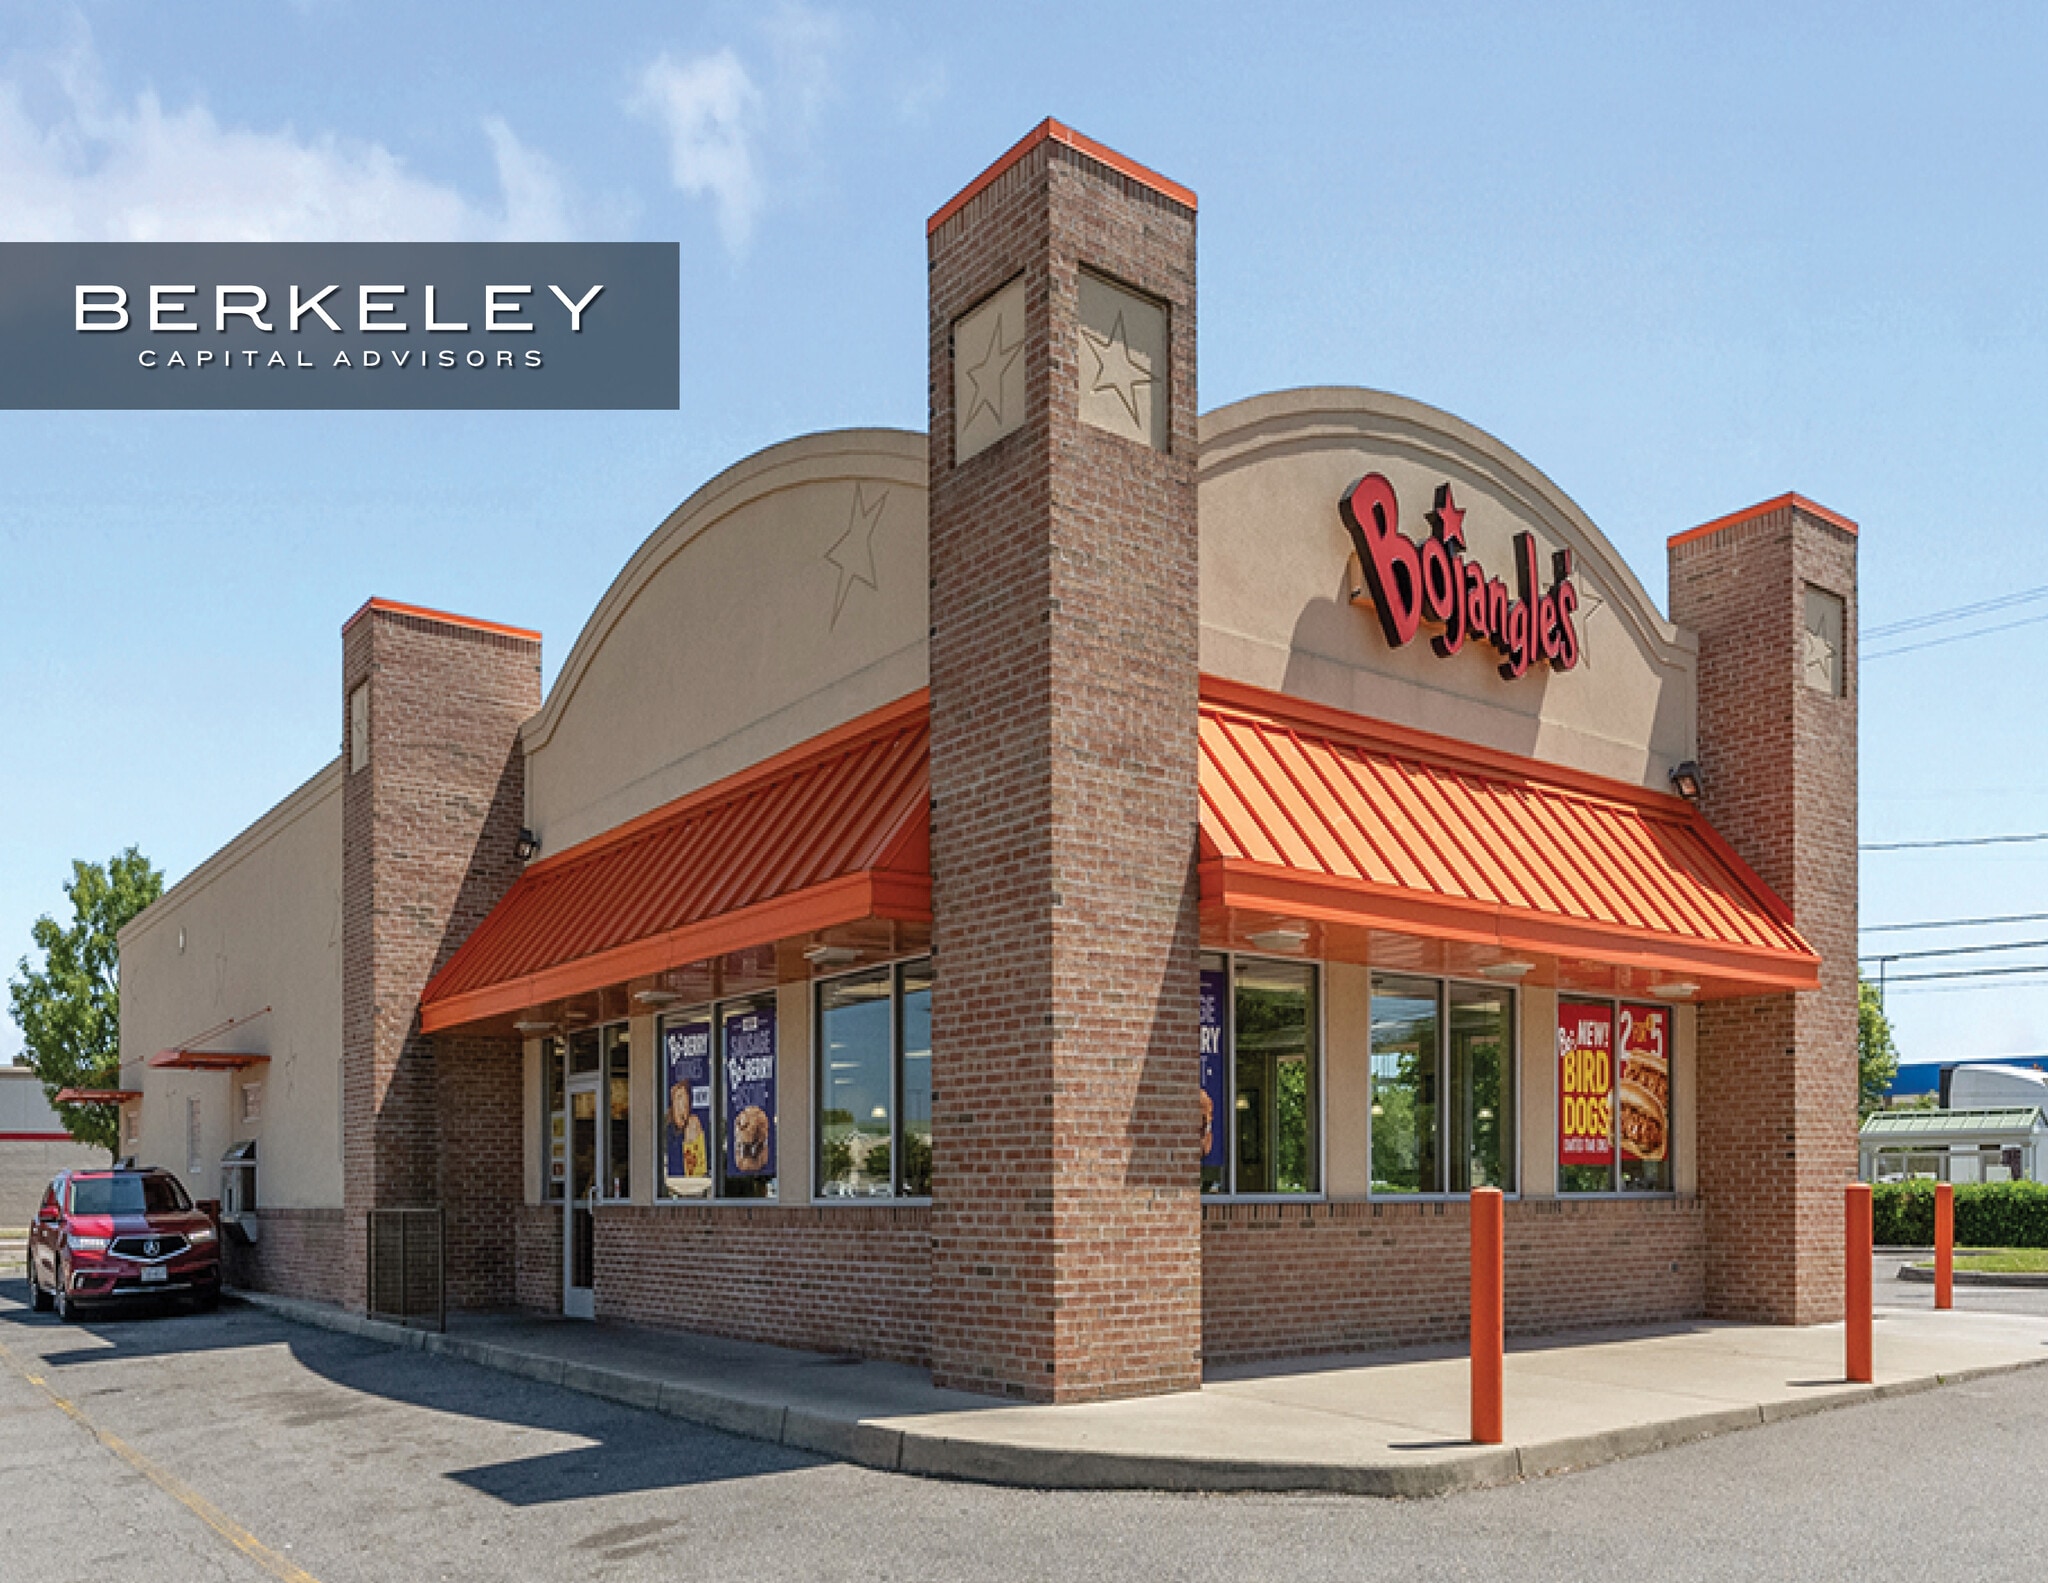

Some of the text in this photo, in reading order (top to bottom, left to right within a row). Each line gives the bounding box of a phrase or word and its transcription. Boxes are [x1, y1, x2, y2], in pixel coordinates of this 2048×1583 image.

[1578, 1020, 1609, 1047] NEW!
[1563, 1049, 1609, 1093] BIRD
[1563, 1096, 1609, 1136] DOGS
